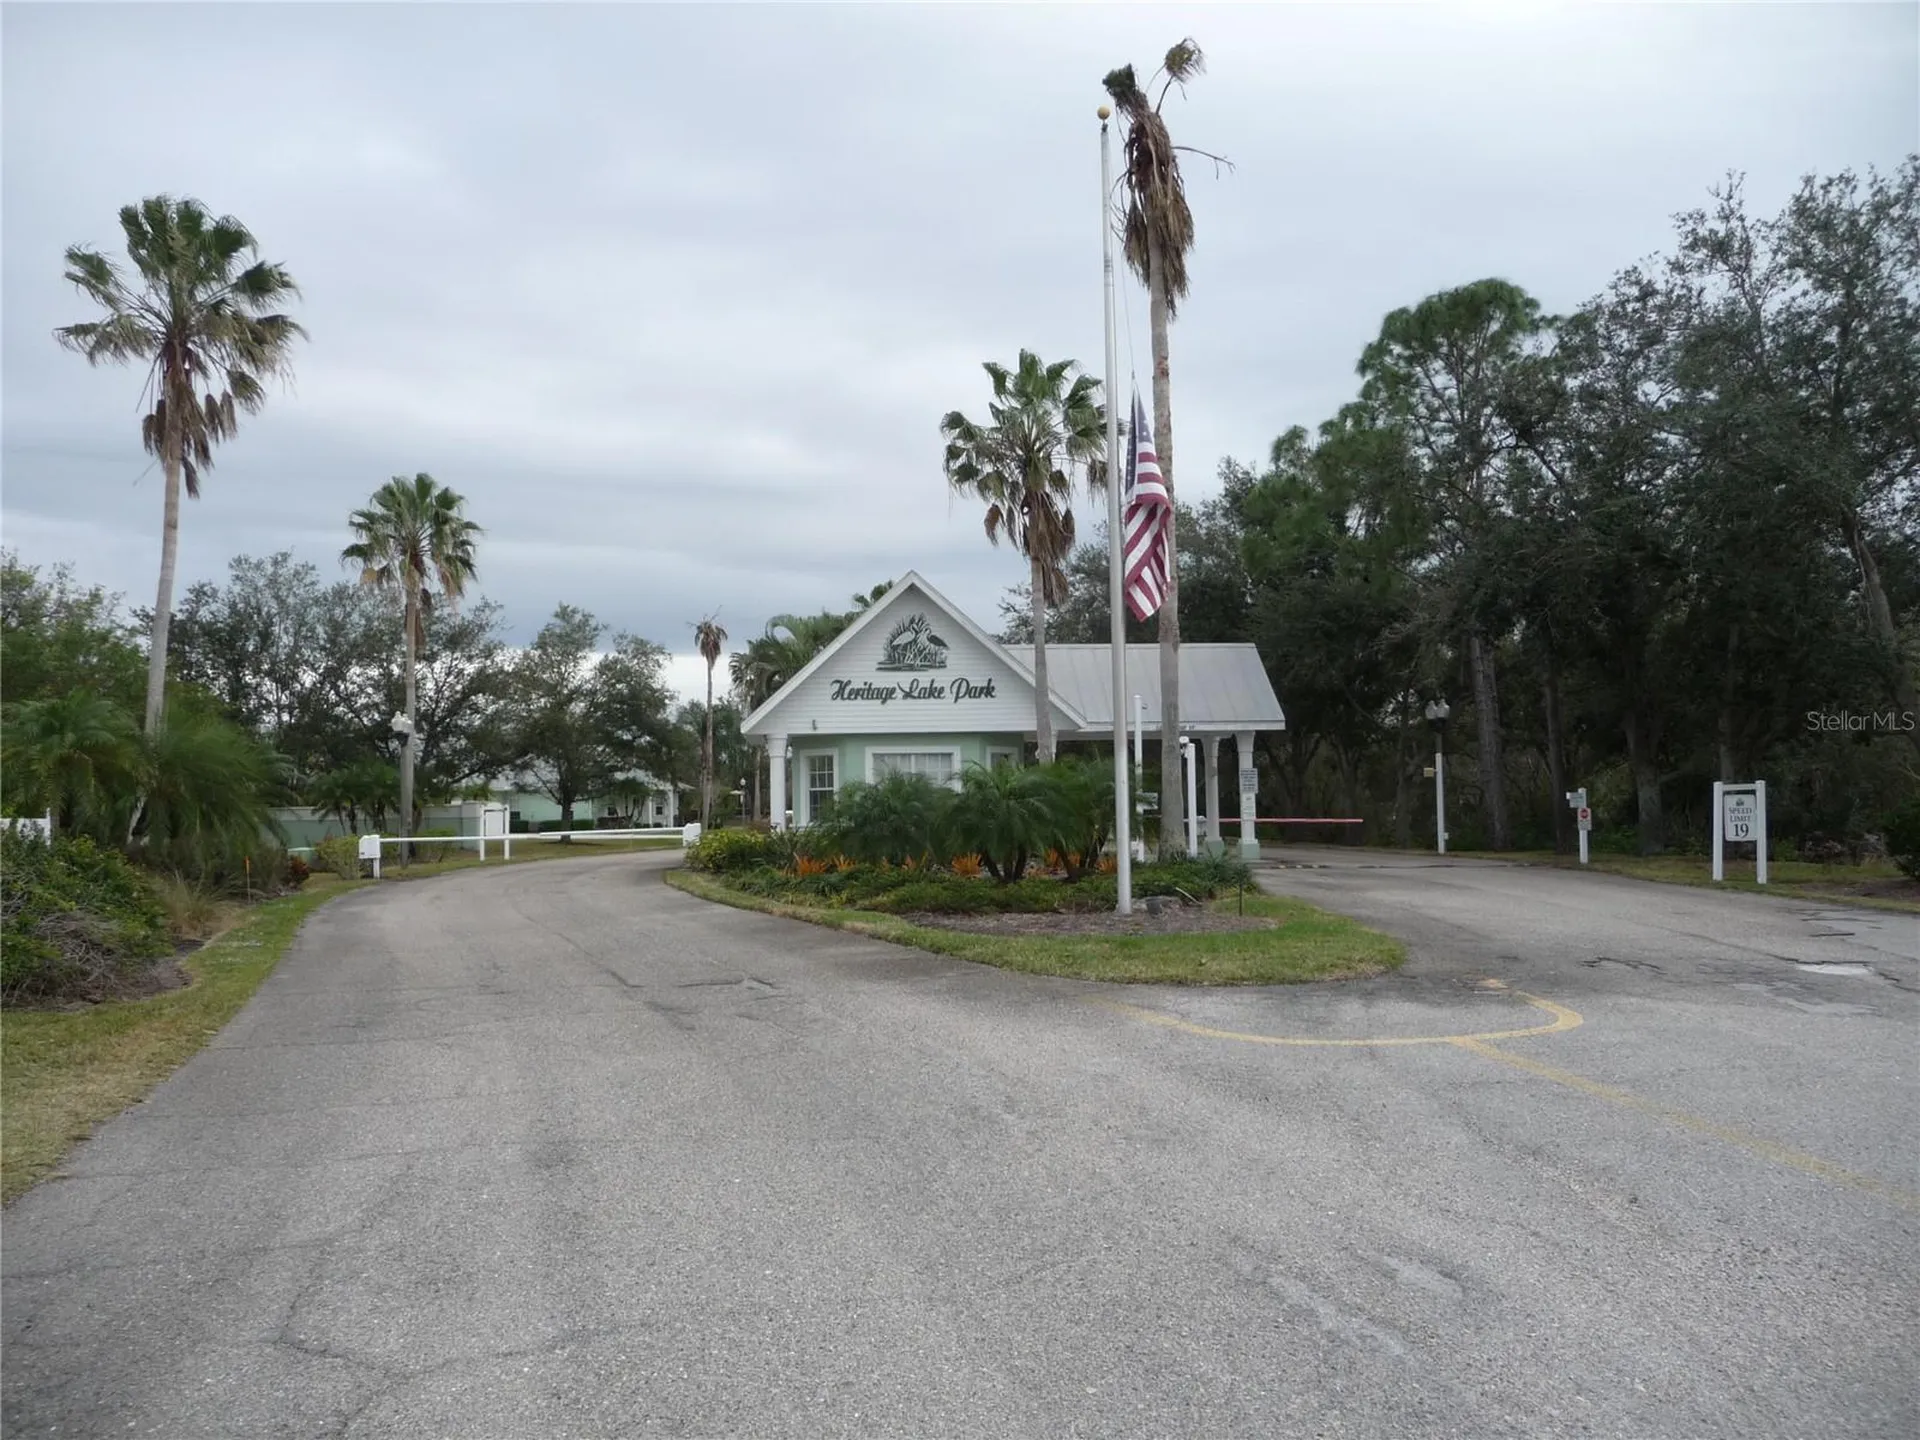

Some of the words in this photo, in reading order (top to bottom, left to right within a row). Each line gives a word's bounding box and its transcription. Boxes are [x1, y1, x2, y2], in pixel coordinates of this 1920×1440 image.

[830, 679, 897, 705] Heritage
[897, 678, 946, 700] Lake
[950, 677, 997, 703] Park
[1728, 807, 1752, 815] SPEED
[1730, 815, 1751, 823] LIMIT
[1734, 823, 1749, 839] 19
